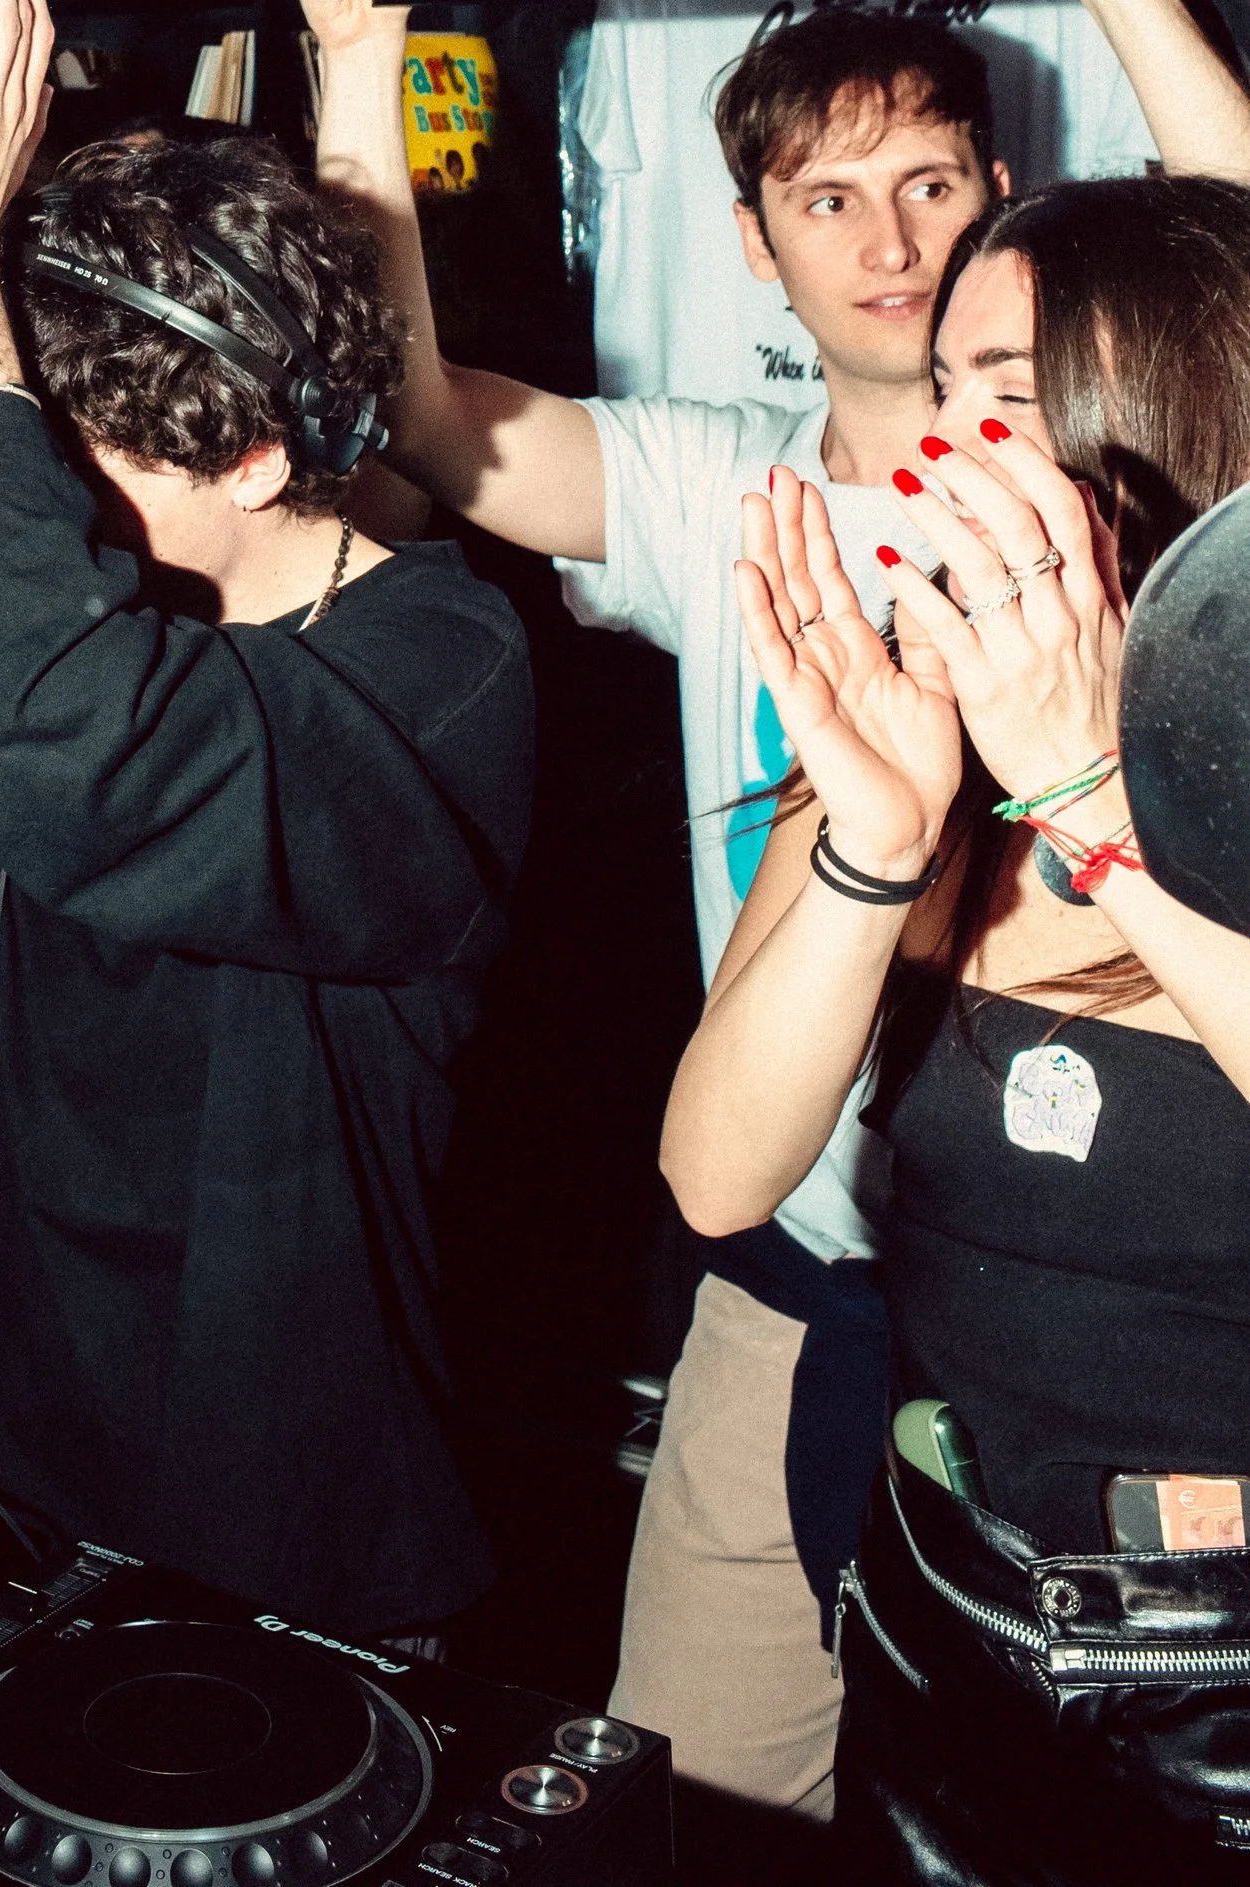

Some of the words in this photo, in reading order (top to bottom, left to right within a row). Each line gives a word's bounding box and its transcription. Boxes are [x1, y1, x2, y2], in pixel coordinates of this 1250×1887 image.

[403, 50, 481, 107] arty
[36, 253, 72, 270] SENNHEISER
[290, 1630, 410, 1674] Pioneer
[466, 1836, 502, 1854] SEARCH
[417, 1862, 453, 1880] SEARCH
